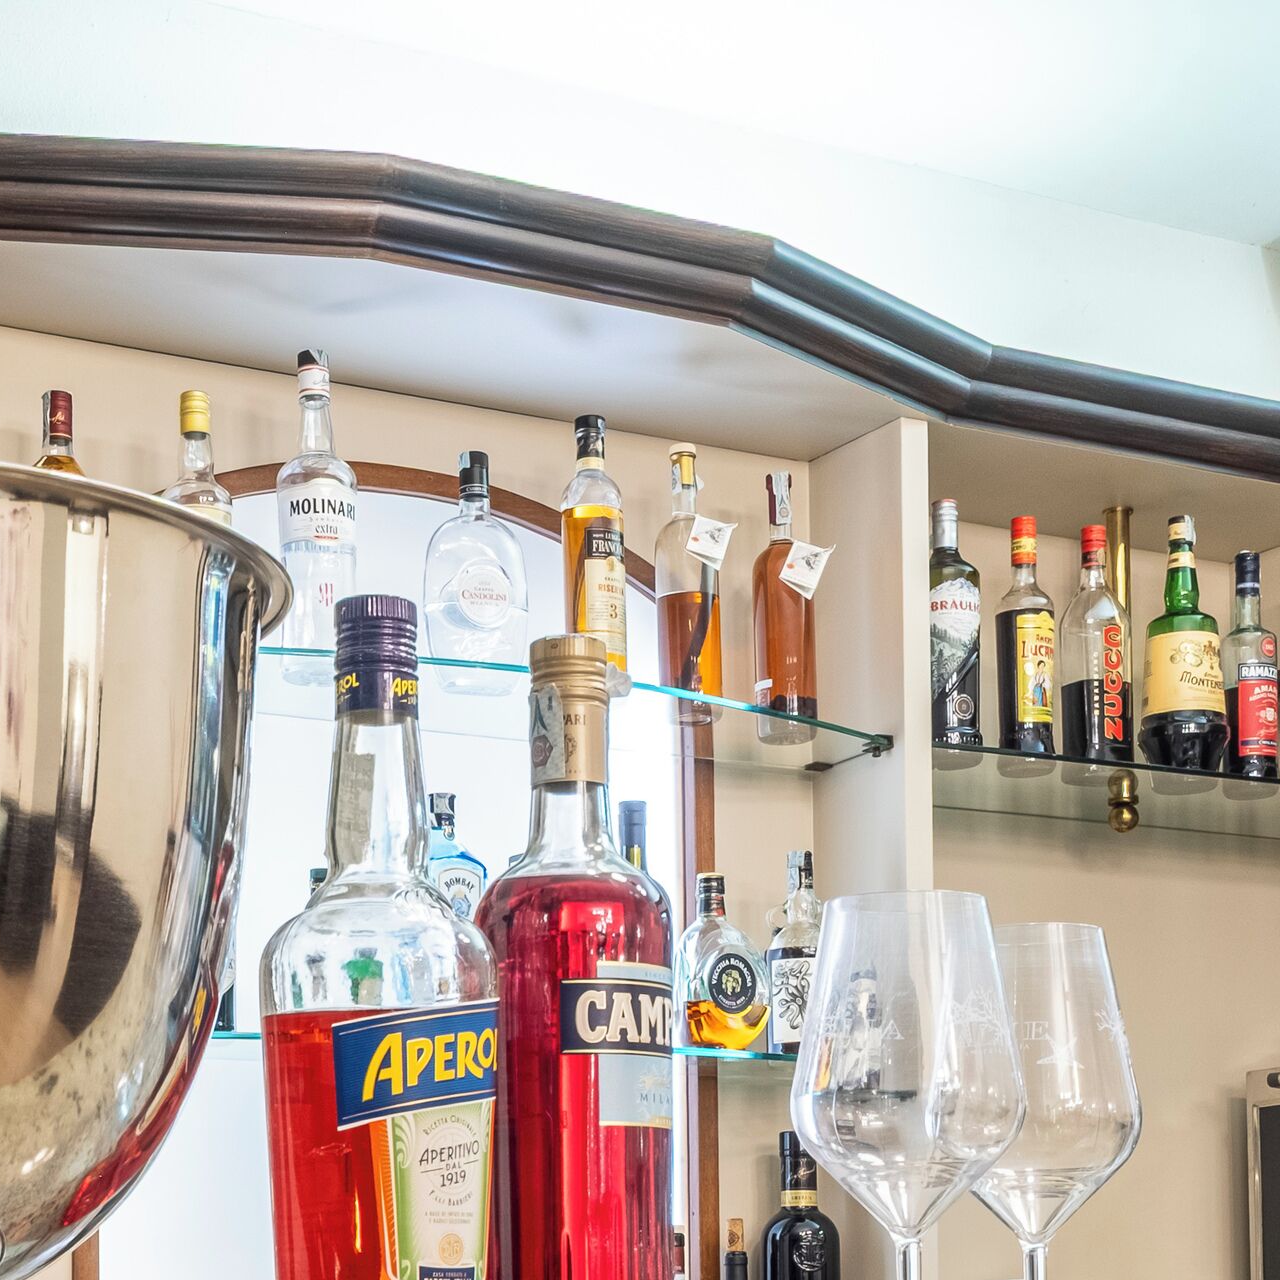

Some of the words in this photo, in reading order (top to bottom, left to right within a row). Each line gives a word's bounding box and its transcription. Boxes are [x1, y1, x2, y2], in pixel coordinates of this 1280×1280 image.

[289, 497, 356, 522] MOLINARI
[461, 589, 508, 602] CANDOLINI
[609, 602, 618, 620] 3
[1103, 624, 1124, 742] ZUCCA
[444, 877, 475, 893] BOMBAY
[419, 1139, 480, 1167] APERITIVO
[445, 1161, 462, 1171] DAL
[439, 1169, 468, 1188] 1919
